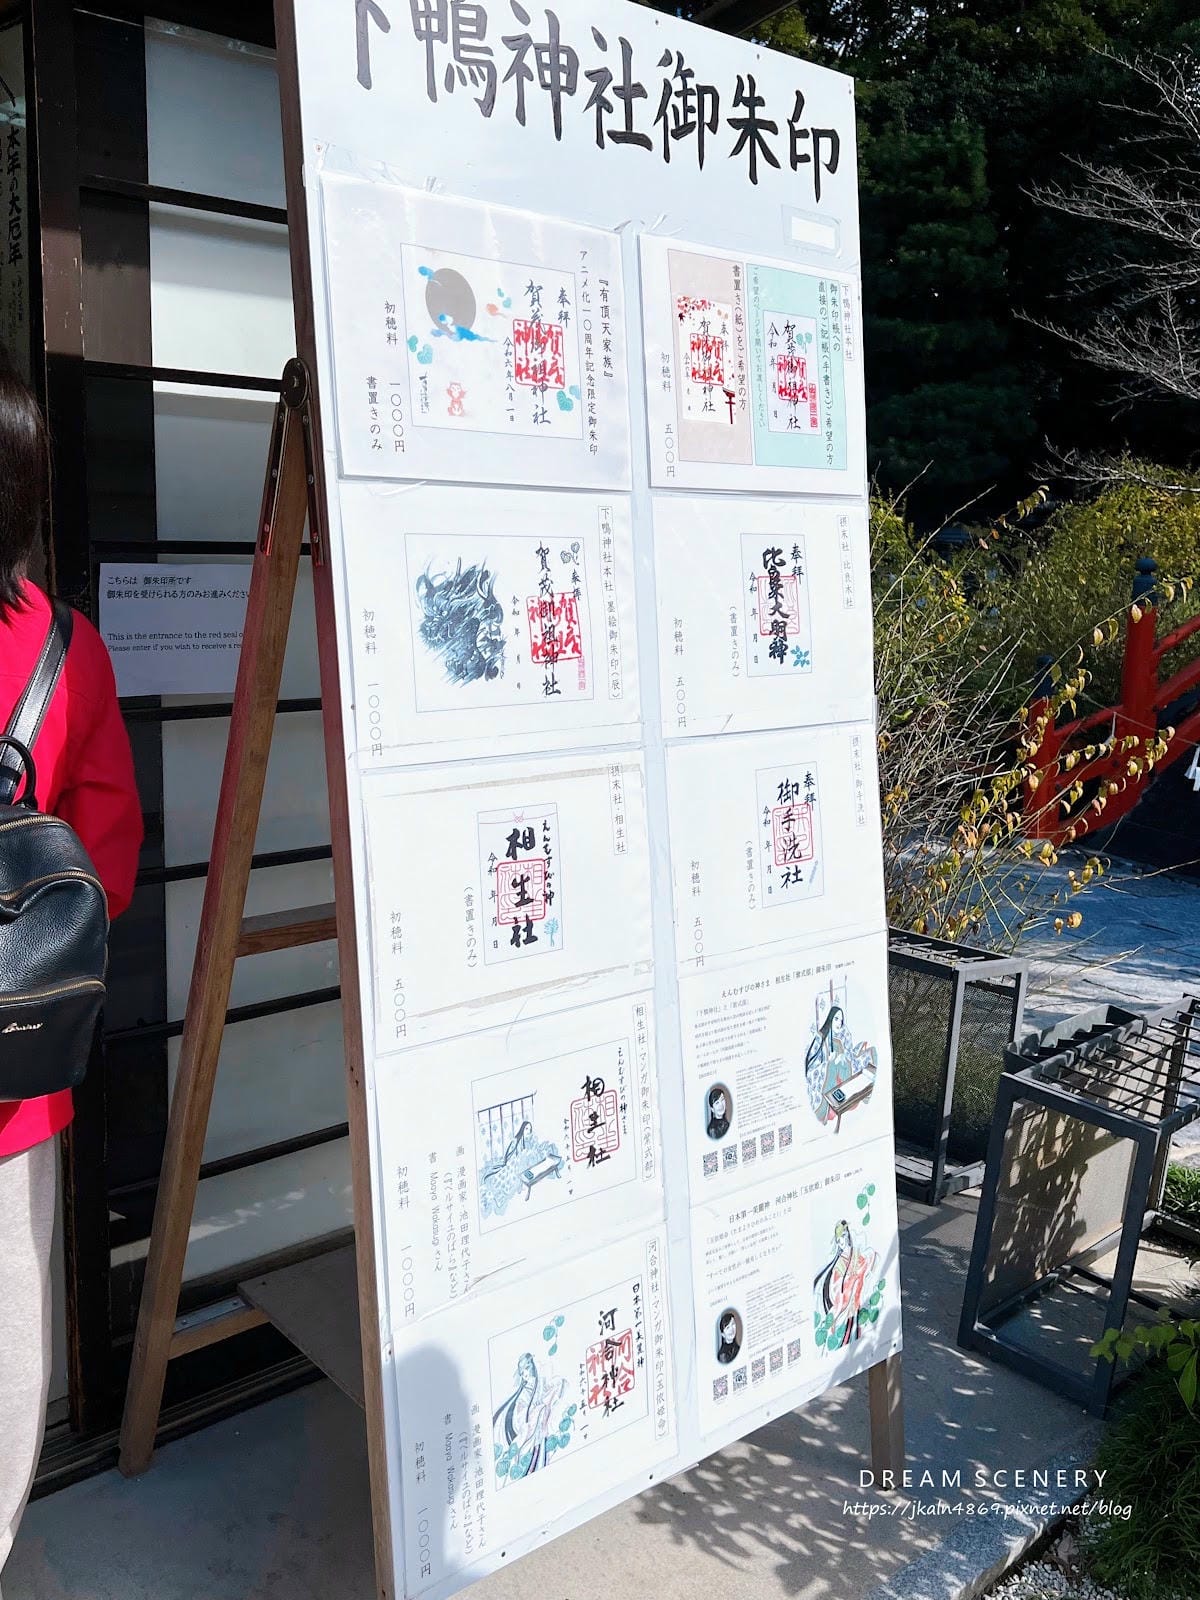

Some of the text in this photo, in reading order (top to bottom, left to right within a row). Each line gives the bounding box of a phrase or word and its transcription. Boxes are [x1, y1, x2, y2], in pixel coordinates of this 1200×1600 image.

[384, 300, 399, 346] 初穂料
[661, 352, 672, 393] 初穂料
[366, 375, 383, 451] 書置きのみ
[107, 576, 192, 585] こちらは 御朱印所です
[107, 633, 125, 641] This
[363, 608, 377, 654] 初穂料
[673, 617, 684, 656] 初穂料
[776, 777, 804, 890] 御手洗社
[505, 826, 539, 949] 相生社
[690, 860, 701, 897] 初穂料
[390, 911, 403, 954] 初穂料
[397, 1166, 410, 1209] 初穂料
